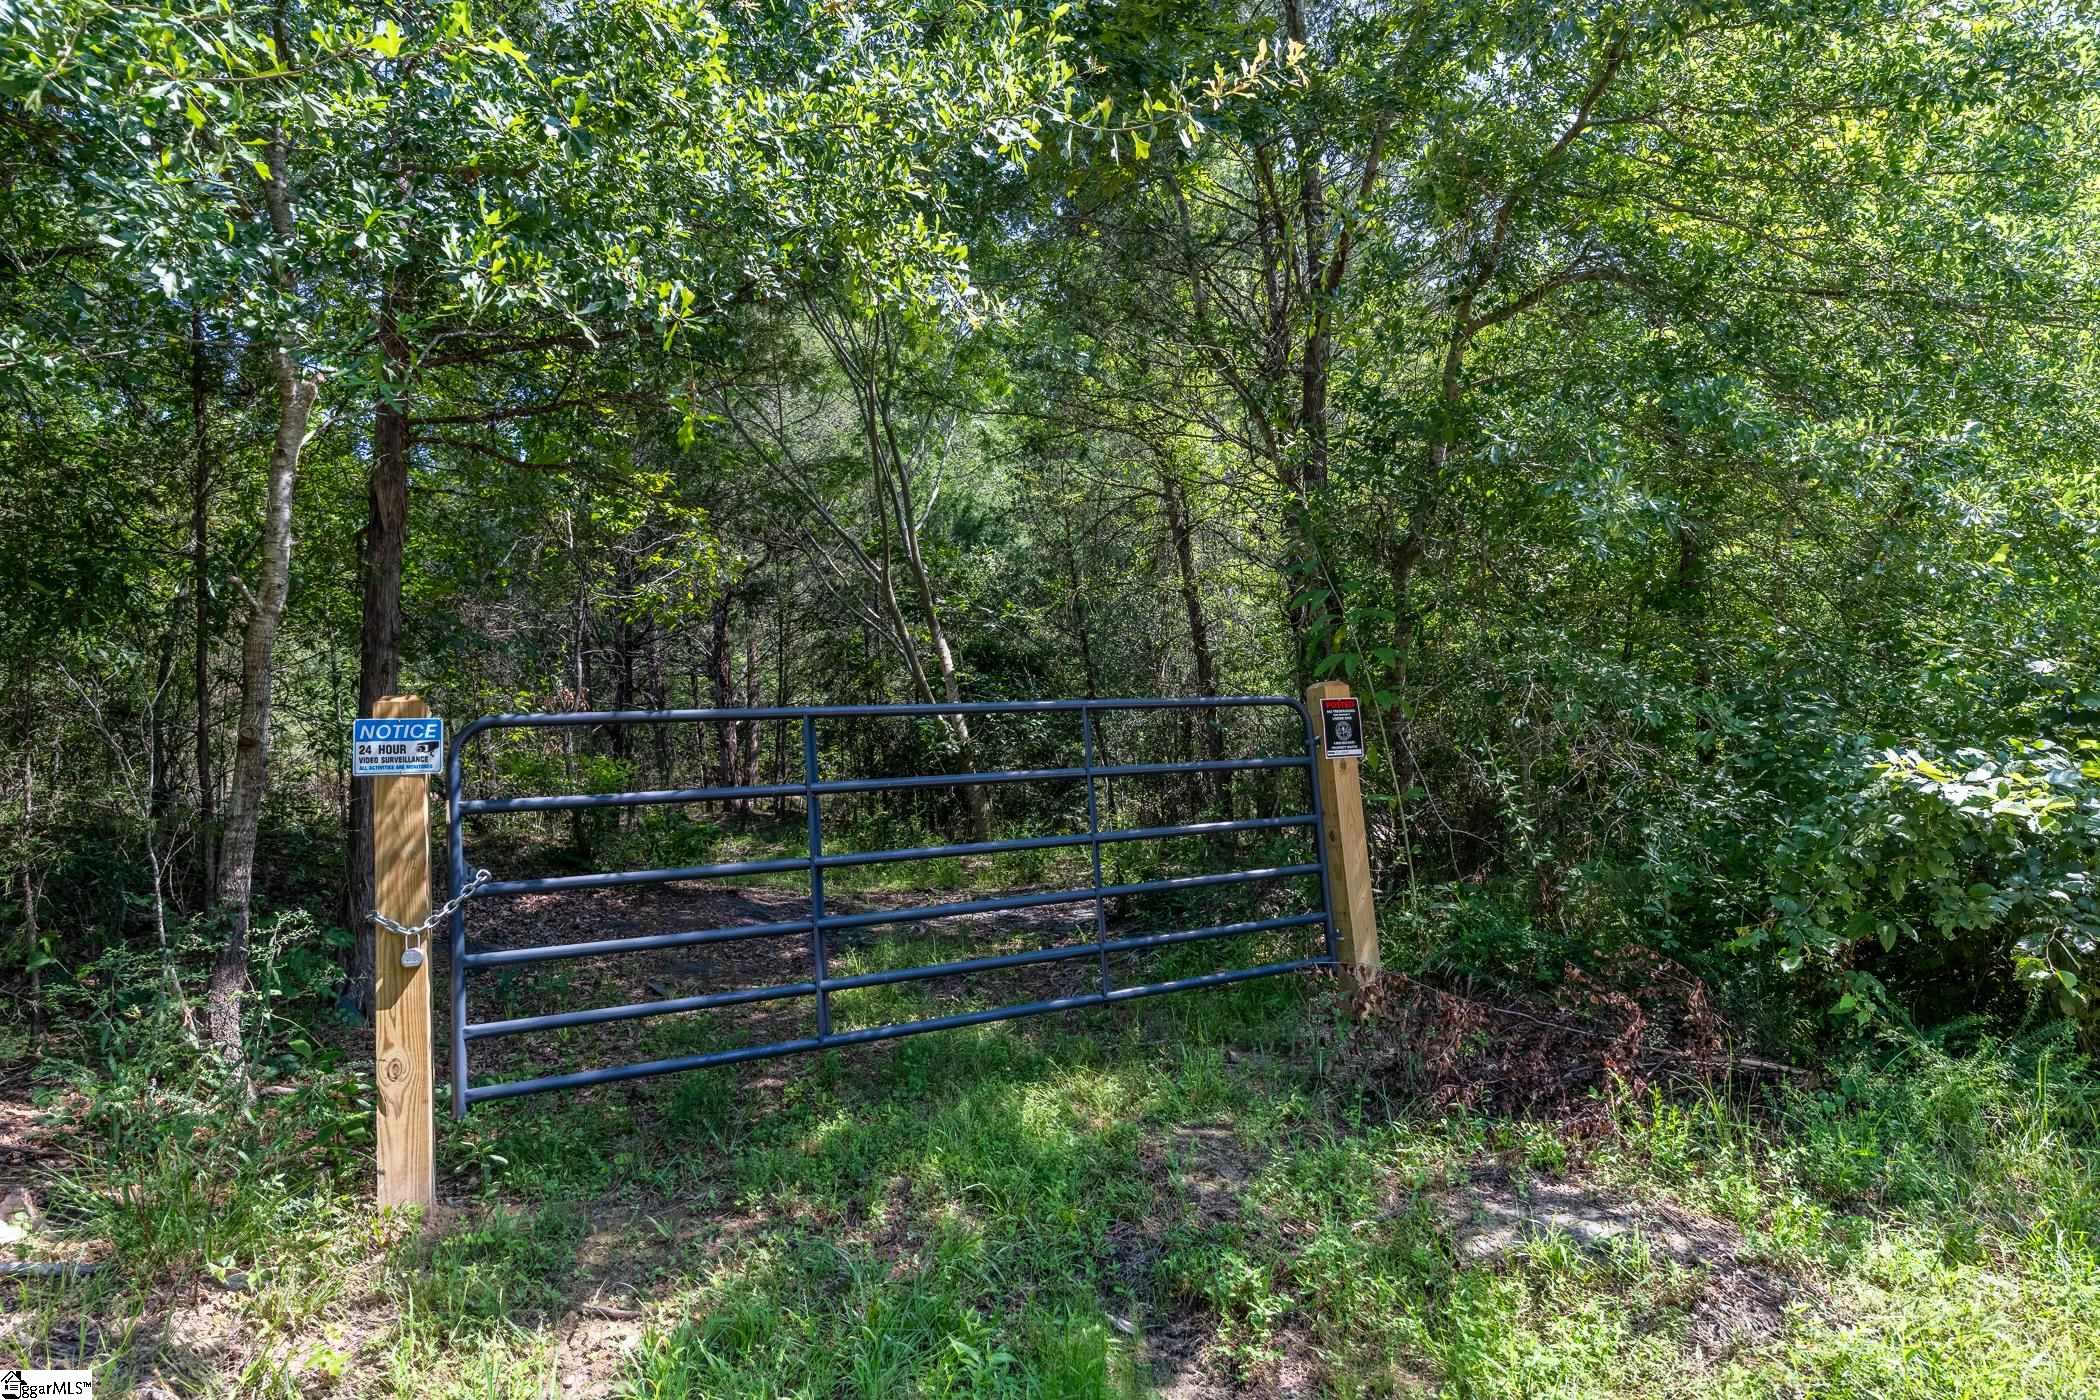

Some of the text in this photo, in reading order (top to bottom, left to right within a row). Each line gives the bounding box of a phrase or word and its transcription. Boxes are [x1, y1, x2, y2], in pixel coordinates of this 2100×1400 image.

[360, 724, 438, 739] NOTICE
[359, 744, 407, 755] 24 HOUR
[359, 755, 429, 764] VIDEO SURVEILLANCE
